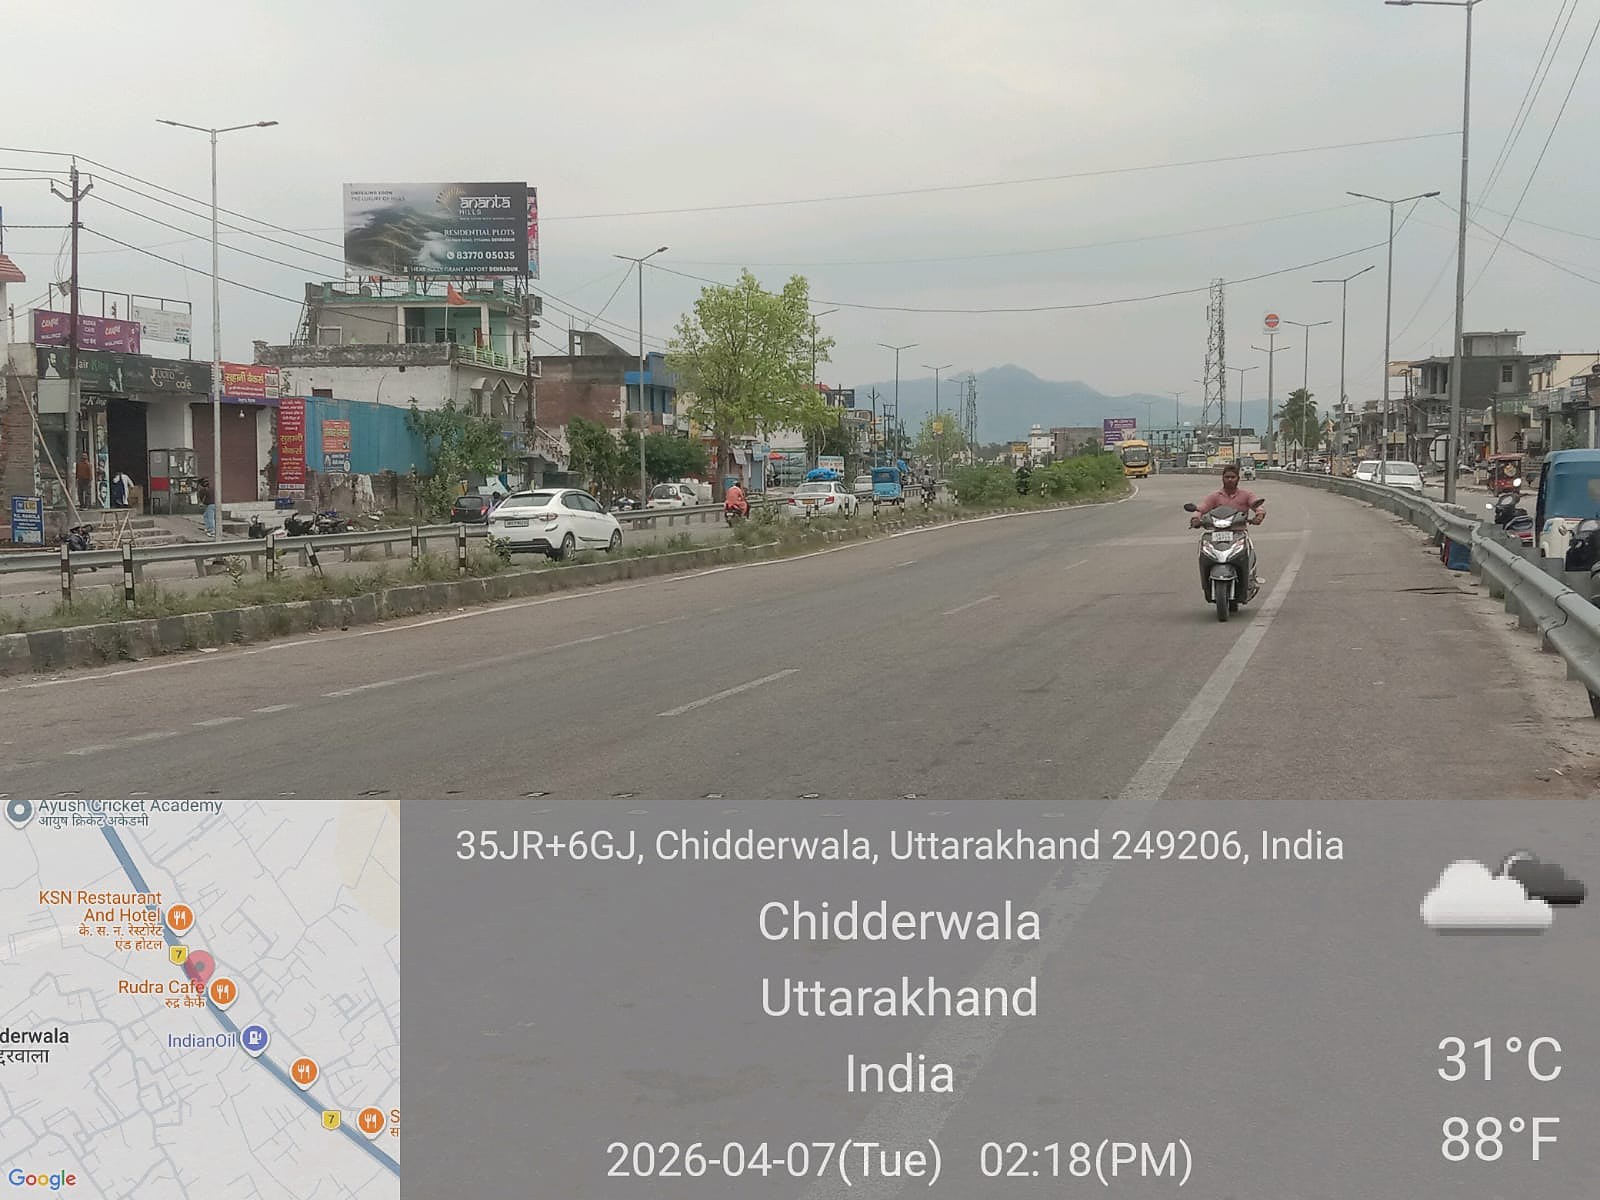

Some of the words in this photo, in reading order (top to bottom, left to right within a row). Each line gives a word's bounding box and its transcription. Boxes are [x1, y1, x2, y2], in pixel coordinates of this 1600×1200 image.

[459, 194, 511, 209] ananta
[443, 229, 491, 237] RESIDENTIAL
[456, 251, 483, 260] 83770
[485, 251, 515, 260] 05035
